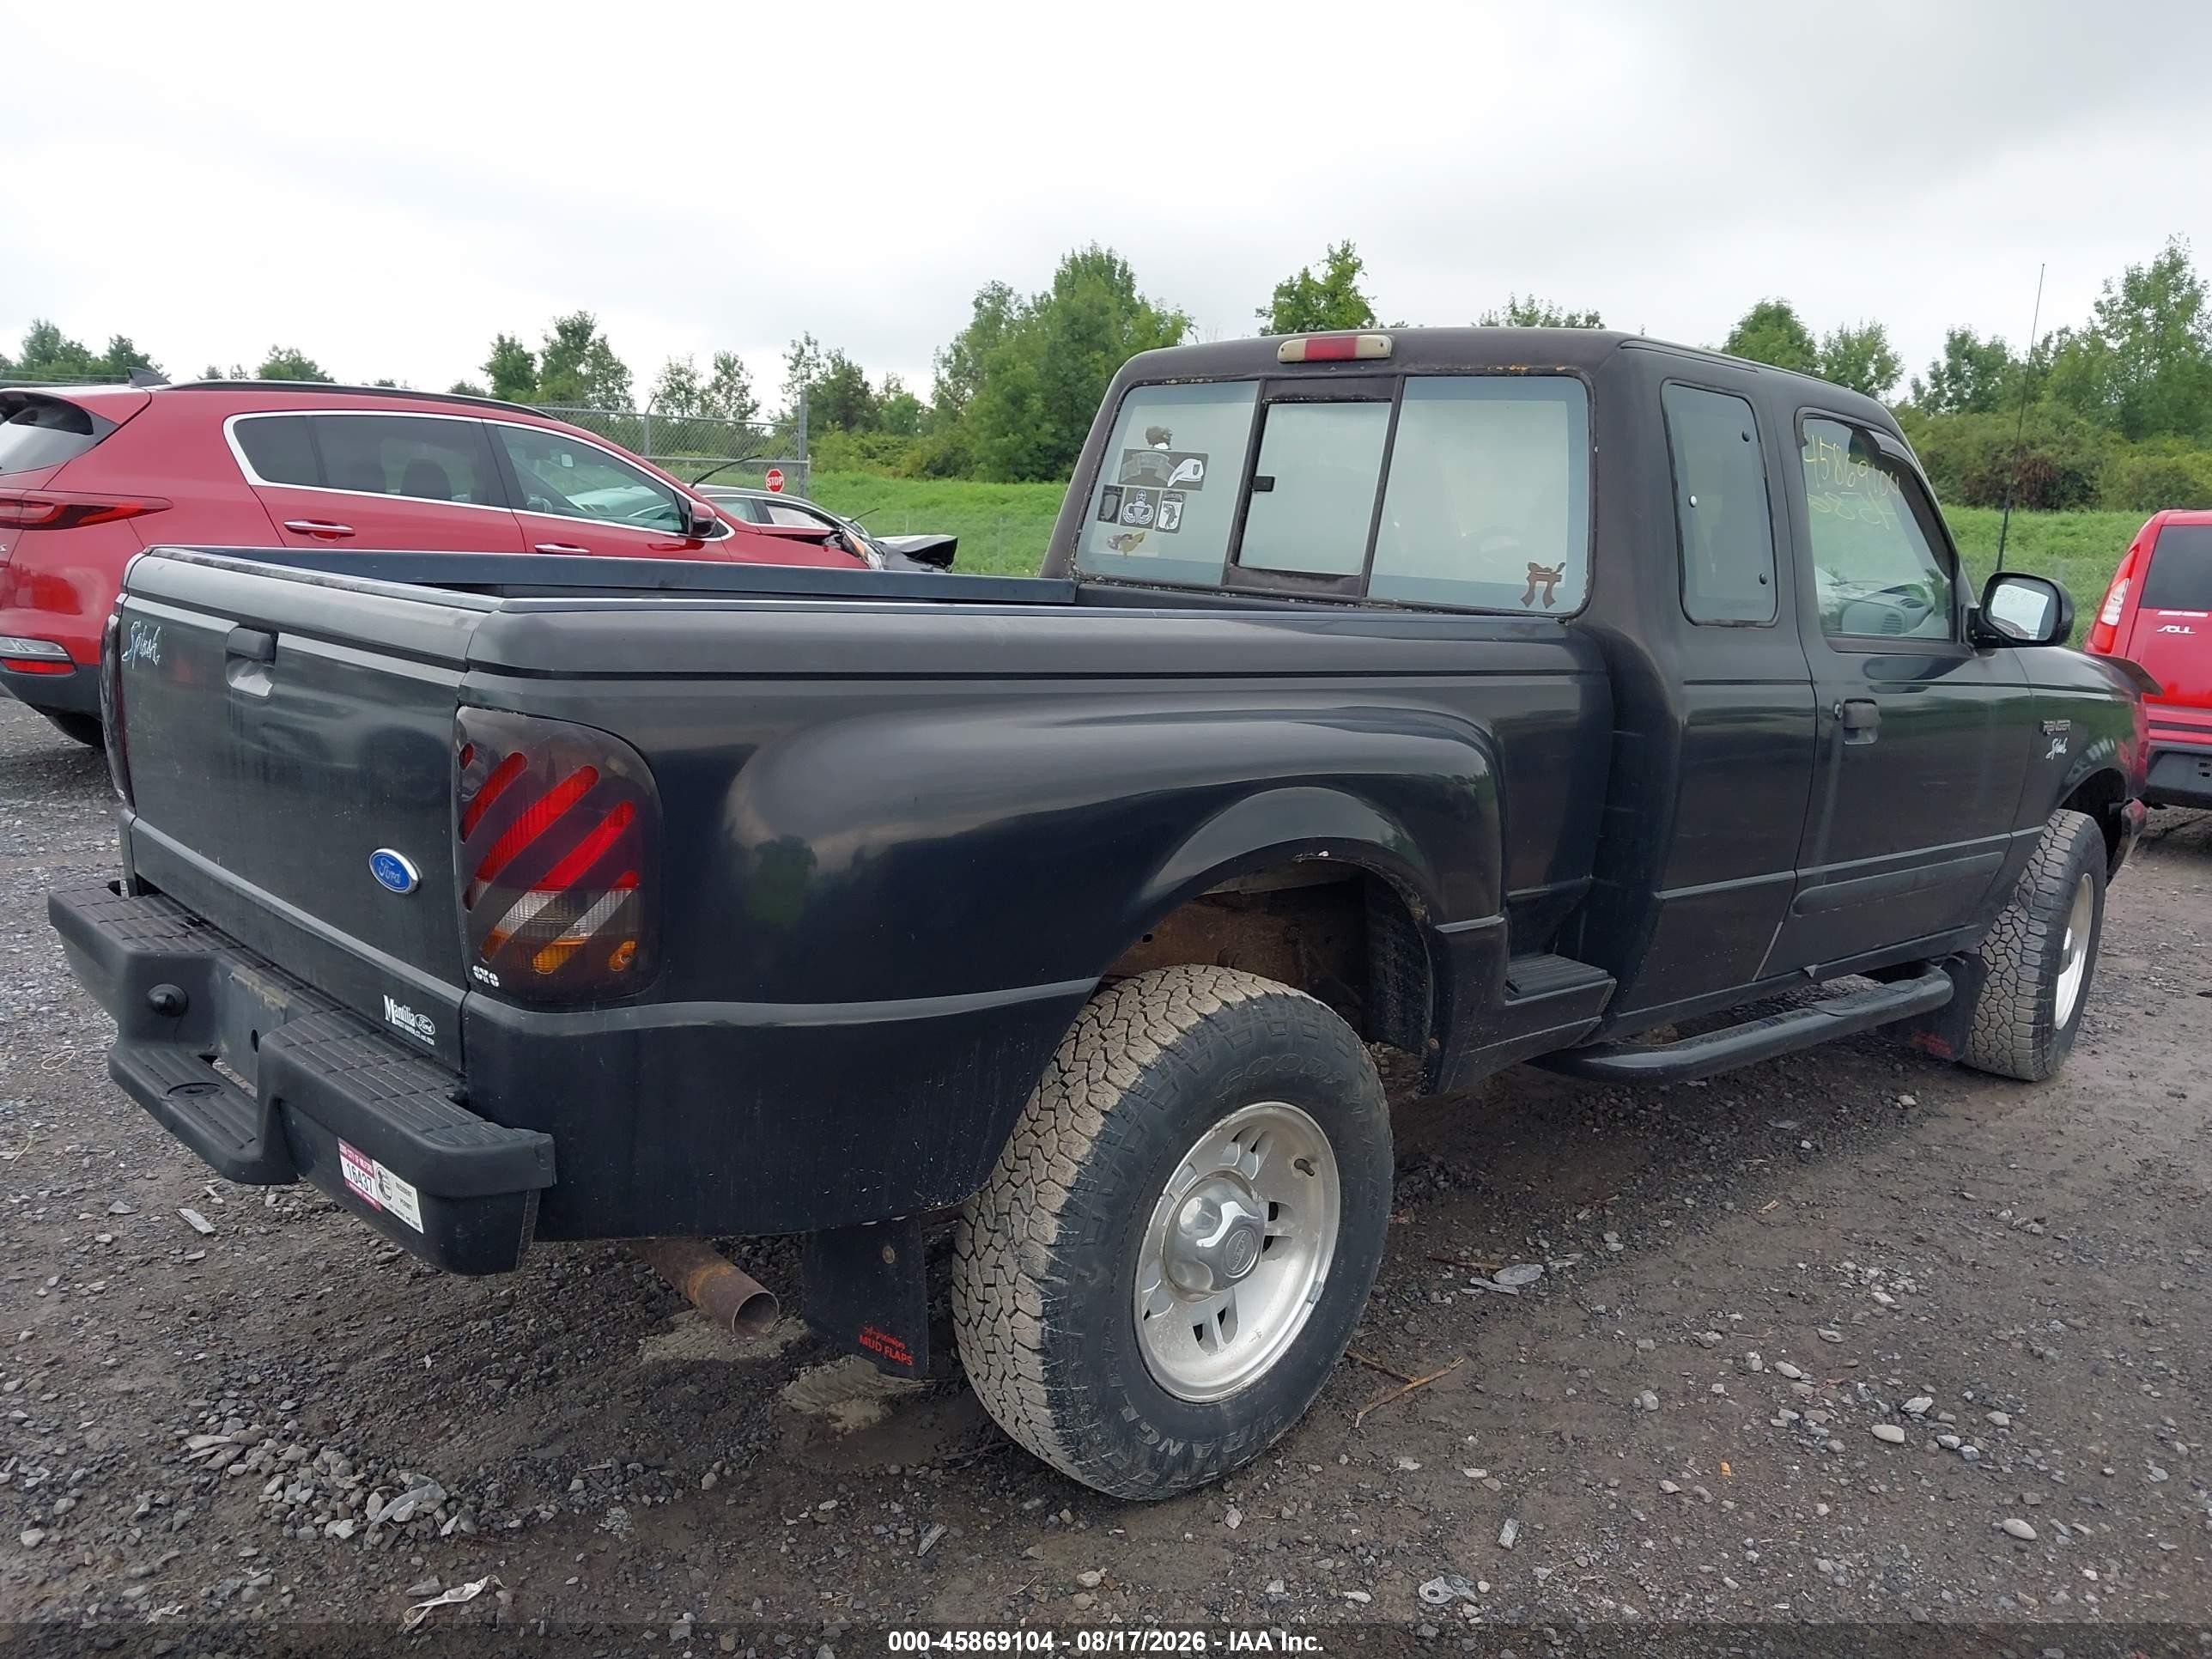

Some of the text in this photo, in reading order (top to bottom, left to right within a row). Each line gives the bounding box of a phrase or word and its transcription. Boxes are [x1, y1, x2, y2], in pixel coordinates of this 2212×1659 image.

[1803, 434, 1899, 496] 45869104
[767, 476, 783, 486] STOP
[122, 620, 161, 670] Splash
[346, 1163, 373, 1194] 16437
[860, 1334, 882, 1352] MUD
[884, 1346, 913, 1365] FLAPS
